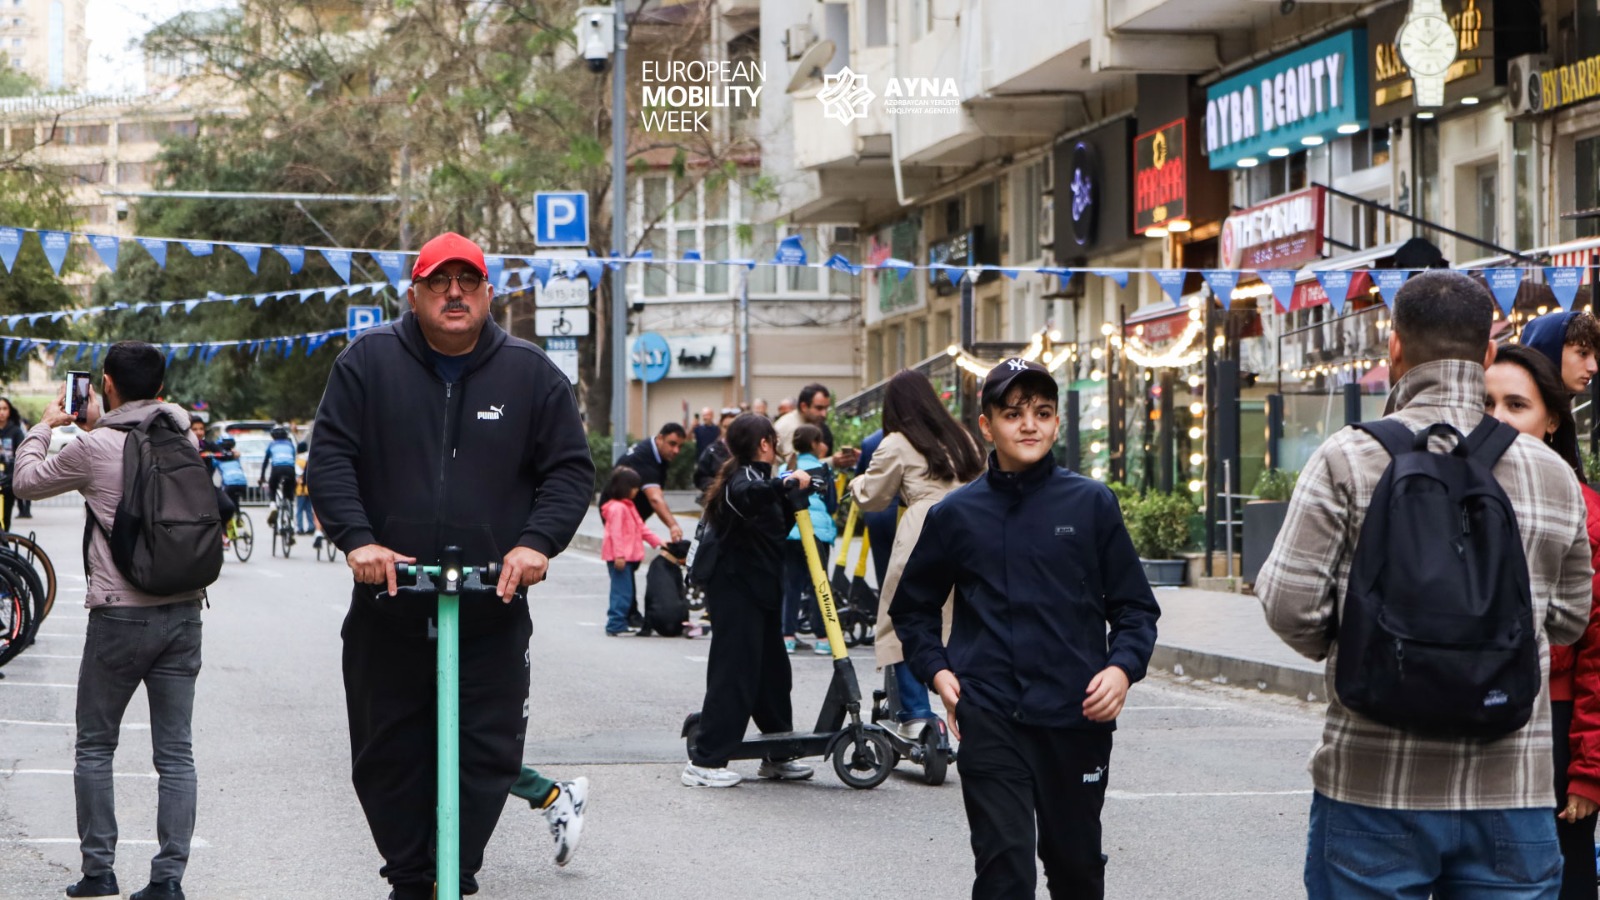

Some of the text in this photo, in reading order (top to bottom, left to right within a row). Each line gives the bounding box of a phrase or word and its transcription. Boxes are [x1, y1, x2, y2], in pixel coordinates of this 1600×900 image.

[1206, 84, 1256, 152] AYBA
[1261, 52, 1341, 132] BEAUTY
[1541, 68, 1558, 110] BY
[547, 197, 577, 240] P
[477, 411, 500, 420] PUMA
